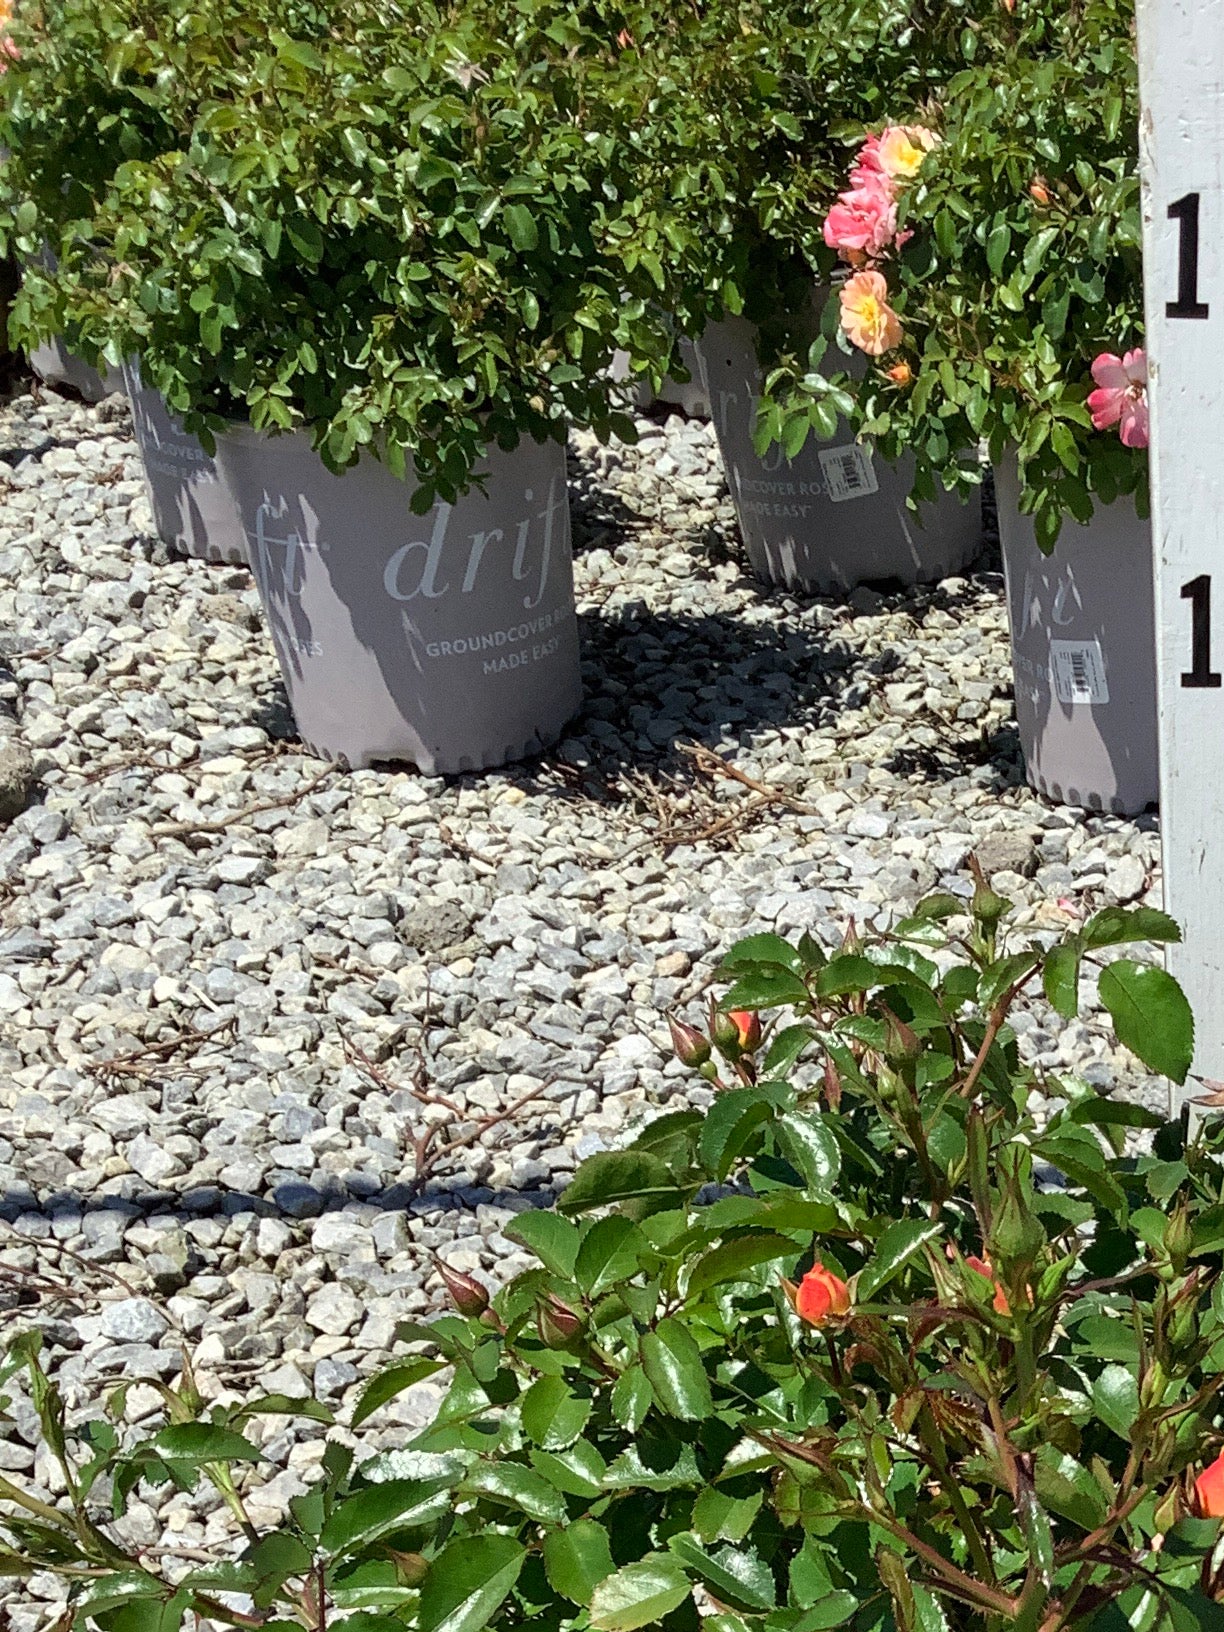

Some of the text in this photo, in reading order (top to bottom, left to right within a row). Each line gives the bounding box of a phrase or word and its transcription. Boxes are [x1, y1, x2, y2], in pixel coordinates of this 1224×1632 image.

[383, 467, 570, 608] drif
[426, 611, 557, 657] GROUNDCOVER
[482, 650, 529, 675] MADE
